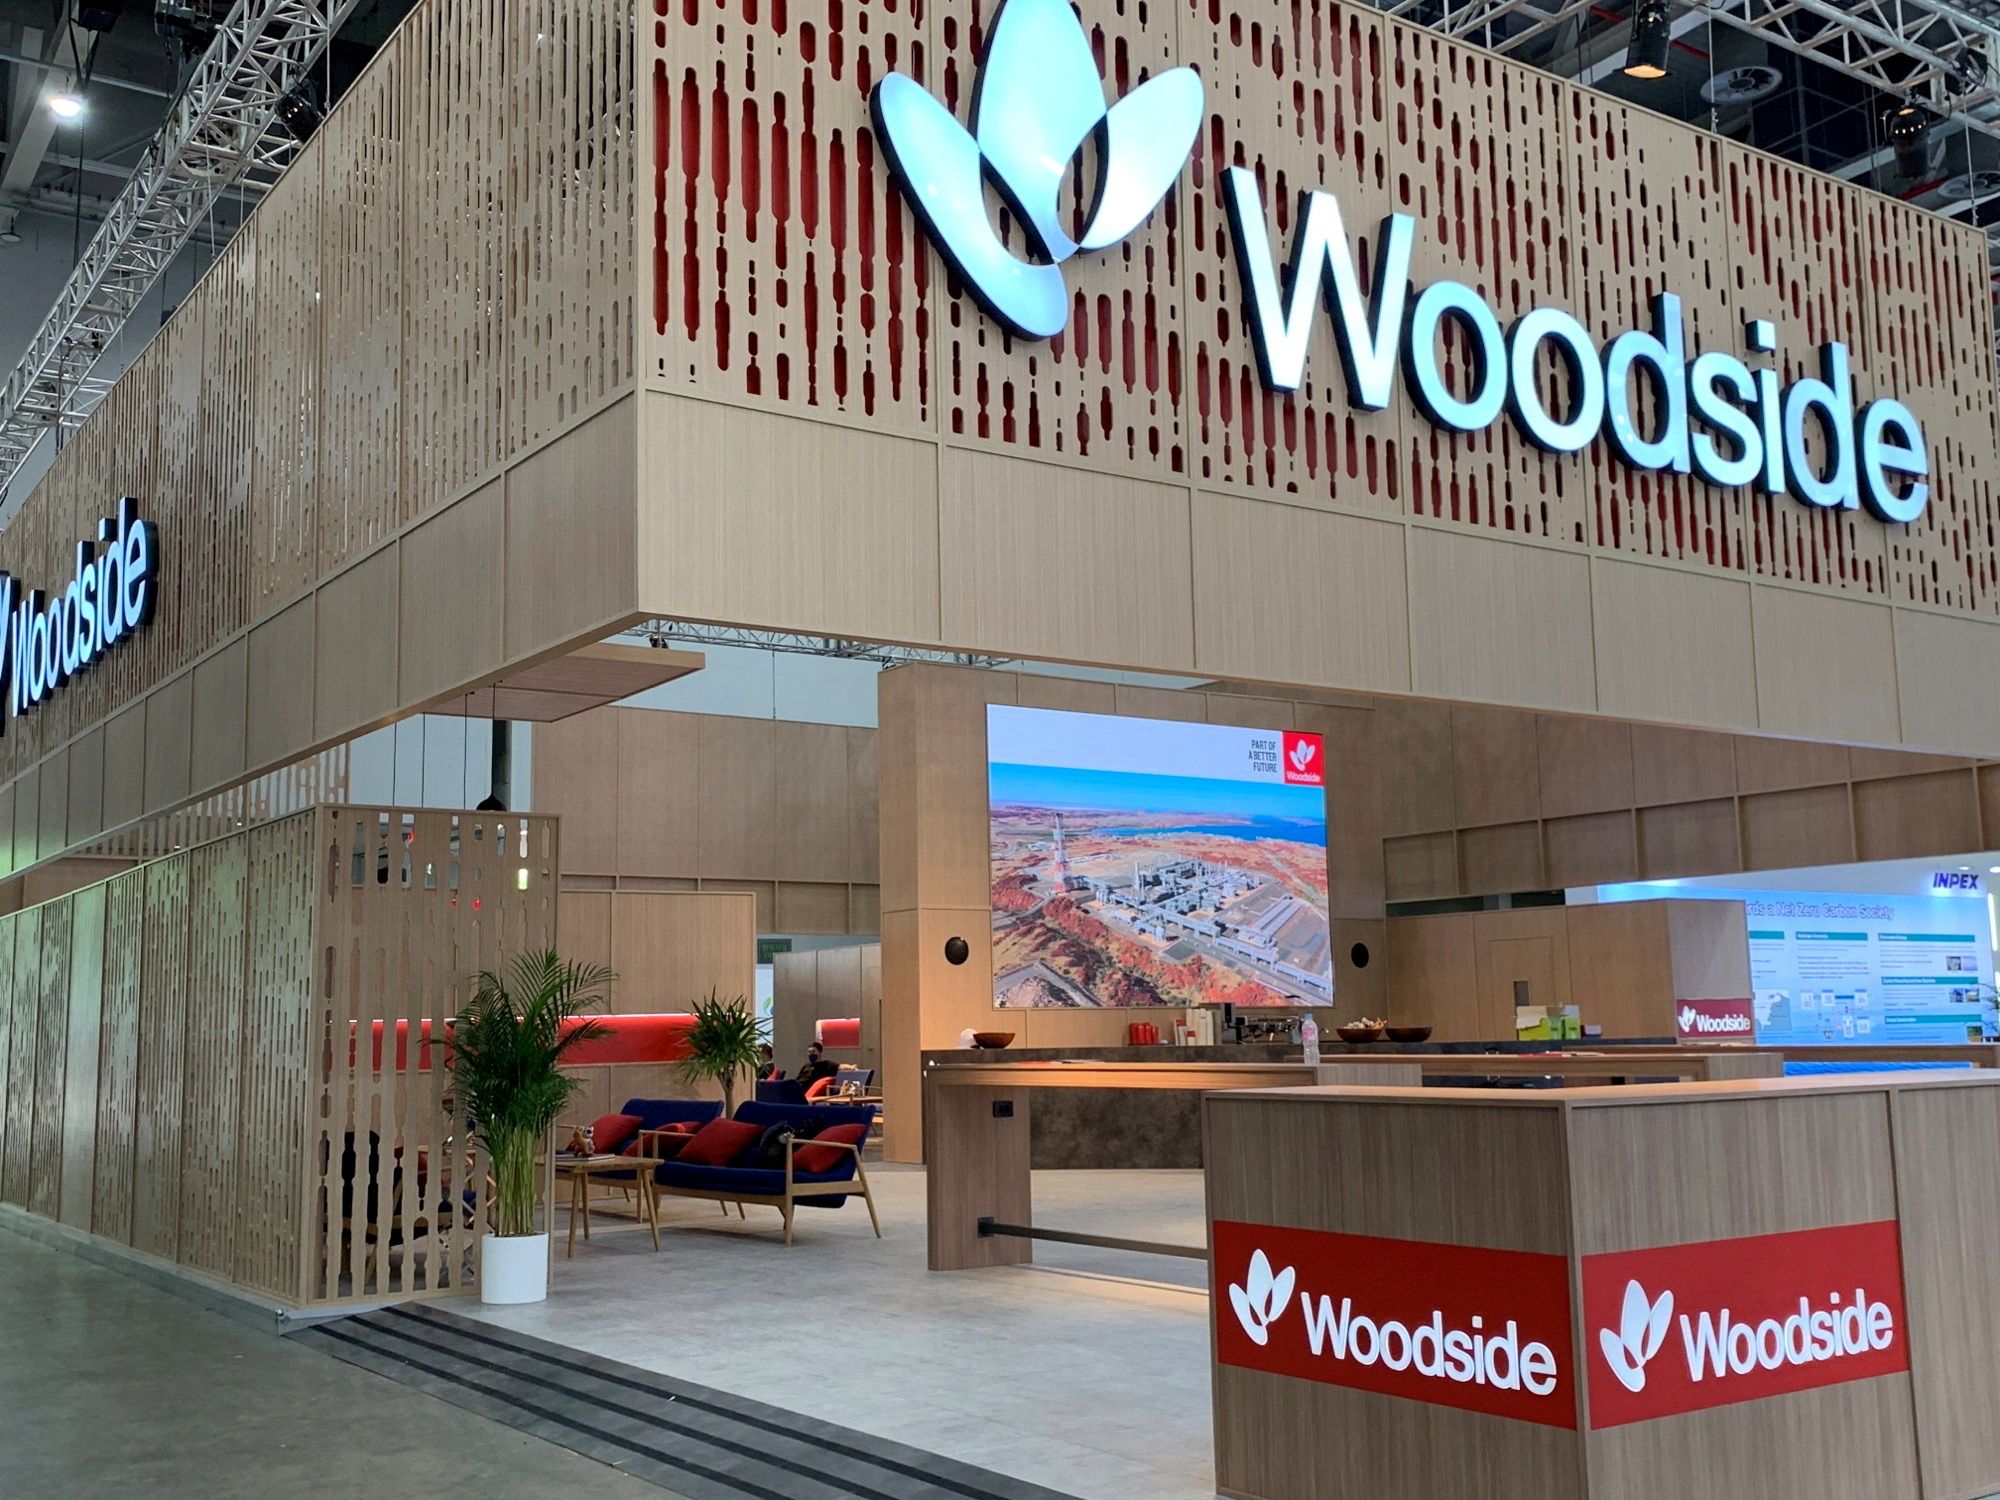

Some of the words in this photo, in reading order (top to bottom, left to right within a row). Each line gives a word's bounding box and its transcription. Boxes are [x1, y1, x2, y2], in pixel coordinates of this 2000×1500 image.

[1221, 165, 1929, 525] Woodside
[11, 496, 150, 718] Woodside
[1251, 739, 1267, 750] PART
[1268, 741, 1277, 751] OF
[1248, 750, 1253, 760] A
[1253, 751, 1278, 762] BETTER
[1253, 762, 1278, 773] FUTURE
[1933, 872, 1979, 890] INPEX
[1746, 901, 1765, 917] rds
[1776, 901, 1796, 917] Net
[1797, 902, 1821, 918] Zero
[1822, 903, 1858, 919] Carbon
[1859, 904, 1894, 921] Society
[1695, 1013, 1751, 1033] Woodside
[1301, 1291, 1557, 1396] Woodside
[1679, 1288, 1893, 1383] Woodside
